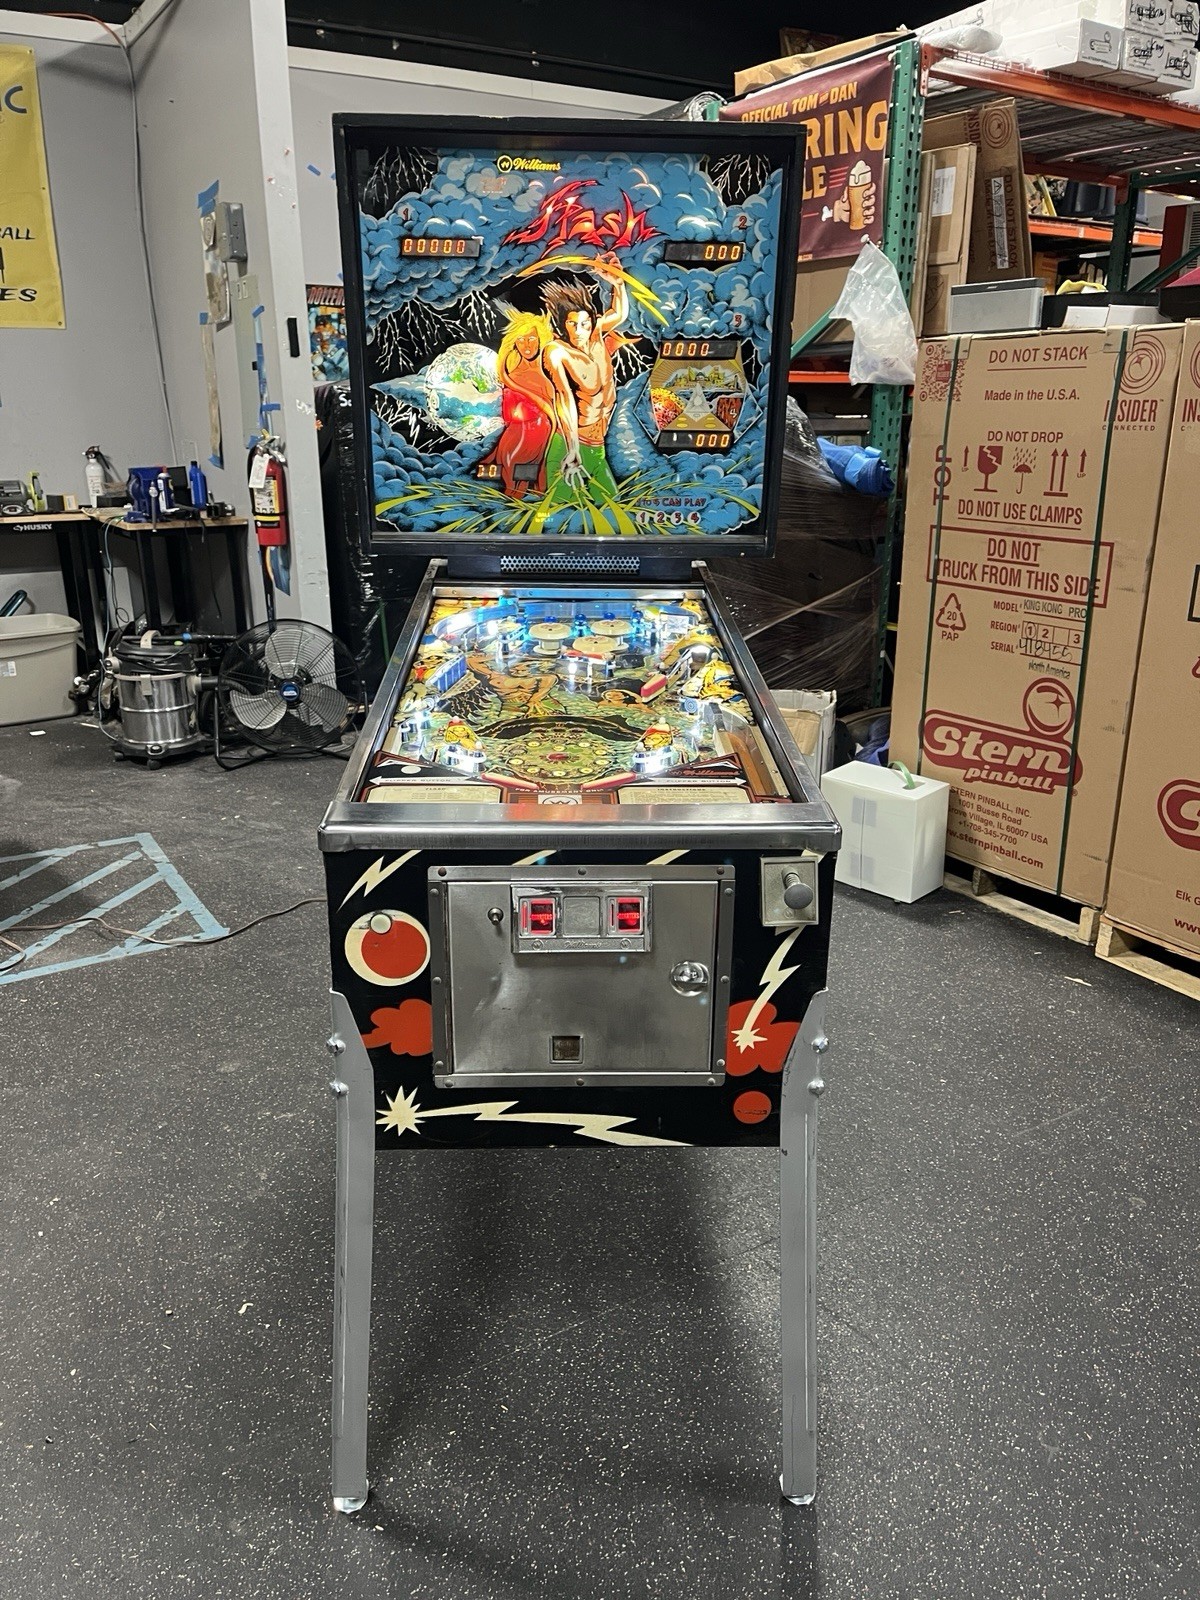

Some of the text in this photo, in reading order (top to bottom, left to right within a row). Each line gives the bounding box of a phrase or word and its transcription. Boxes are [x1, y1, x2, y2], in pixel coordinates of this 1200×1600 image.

[0, 85, 28, 114] C
[741, 102, 789, 122] OFFICIAL
[792, 92, 819, 114] TOM
[829, 81, 858, 105] DAN
[513, 157, 561, 172] Williams
[1004, 174, 1014, 194] DO
[502, 180, 668, 259] Flash
[1006, 197, 1016, 225] NOT
[739, 215, 747, 230] 2
[0, 226, 36, 240] ALL
[403, 238, 466, 254] 00000
[988, 345, 1089, 364] DO NOT STACK
[984, 388, 1080, 401] Made in the U.S.A.
[1103, 399, 1158, 422] ISIDER
[987, 431, 1064, 443] DO NOT DROP
[662, 497, 682, 507] CAN
[684, 497, 707, 507] PLAY
[656, 511, 665, 523] 2
[958, 499, 1083, 526] DO NOT USE CLAMPS
[23, 523, 52, 531] HUSKY
[987, 537, 1042, 562] DO NOT
[937, 558, 1101, 599] TRUCK FROM THIS SIDE
[946, 610, 958, 621] 20
[1023, 599, 1041, 612] KING
[1041, 601, 1063, 615] KONG
[1068, 607, 1088, 619] PRO
[941, 630, 959, 642] PAP
[1041, 628, 1050, 639] 2
[1072, 633, 1081, 645] 3
[1028, 659, 1072, 680] North America
[933, 725, 1072, 775] Stern
[964, 763, 1054, 791] pinball
[950, 785, 976, 800] STERN
[1015, 806, 1032, 819] INC.
[958, 798, 1022, 826] 1001 Busse Road
[948, 805, 967, 817] rove
[1005, 825, 1029, 839] 60007
[1030, 833, 1049, 846] USA
[1175, 889, 1191, 902] Elk
